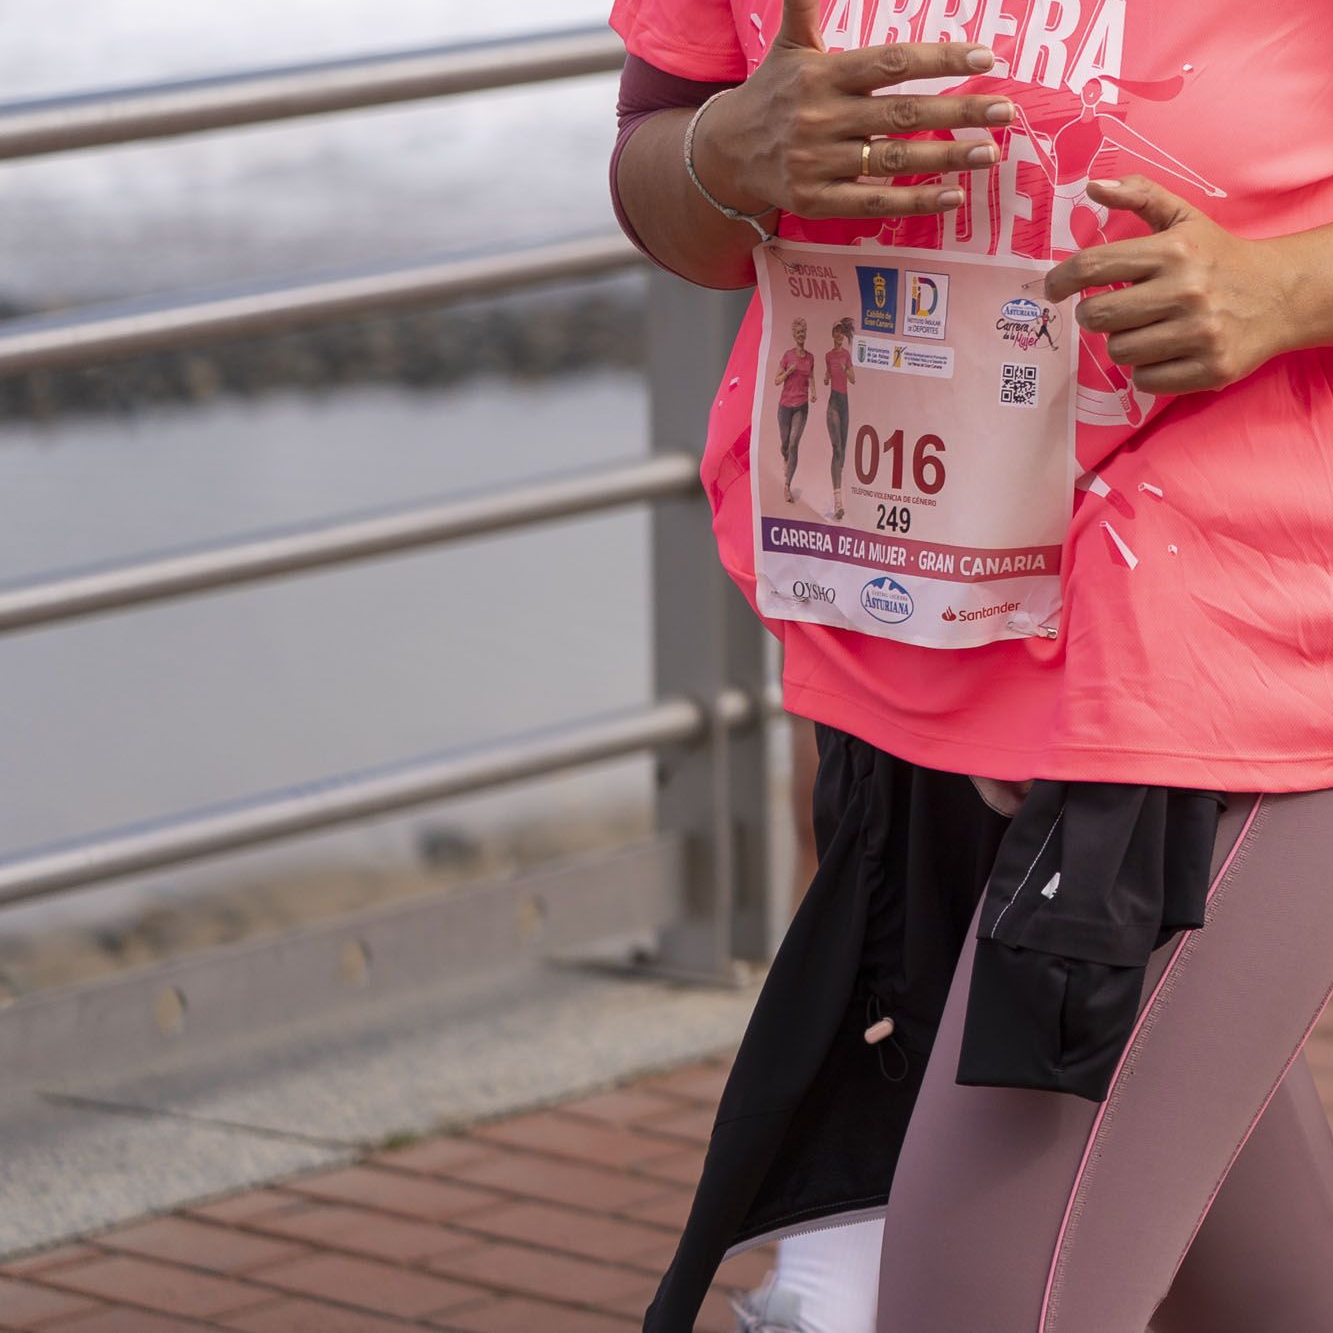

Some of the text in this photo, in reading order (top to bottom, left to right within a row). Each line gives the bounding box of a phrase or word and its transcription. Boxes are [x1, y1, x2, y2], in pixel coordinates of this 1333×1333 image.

[788, 276, 842, 302] SUMA
[913, 325, 938, 335] DEPORTES
[996, 318, 1029, 332] Carrera
[1002, 332, 1009, 340] de
[1014, 333, 1040, 351] Mujer
[854, 424, 946, 495] 016
[851, 487, 874, 498] TELÉFONO
[874, 491, 902, 502] VIOLENCIA
[912, 496, 937, 506] GÉNERO
[876, 504, 911, 533] 249
[770, 526, 1046, 576] CARRERA DE LA MUJER GRAN CANARIA
[792, 581, 836, 604] OYSHO
[865, 590, 909, 615] ASTURIANA
[958, 602, 1022, 622] Santander
